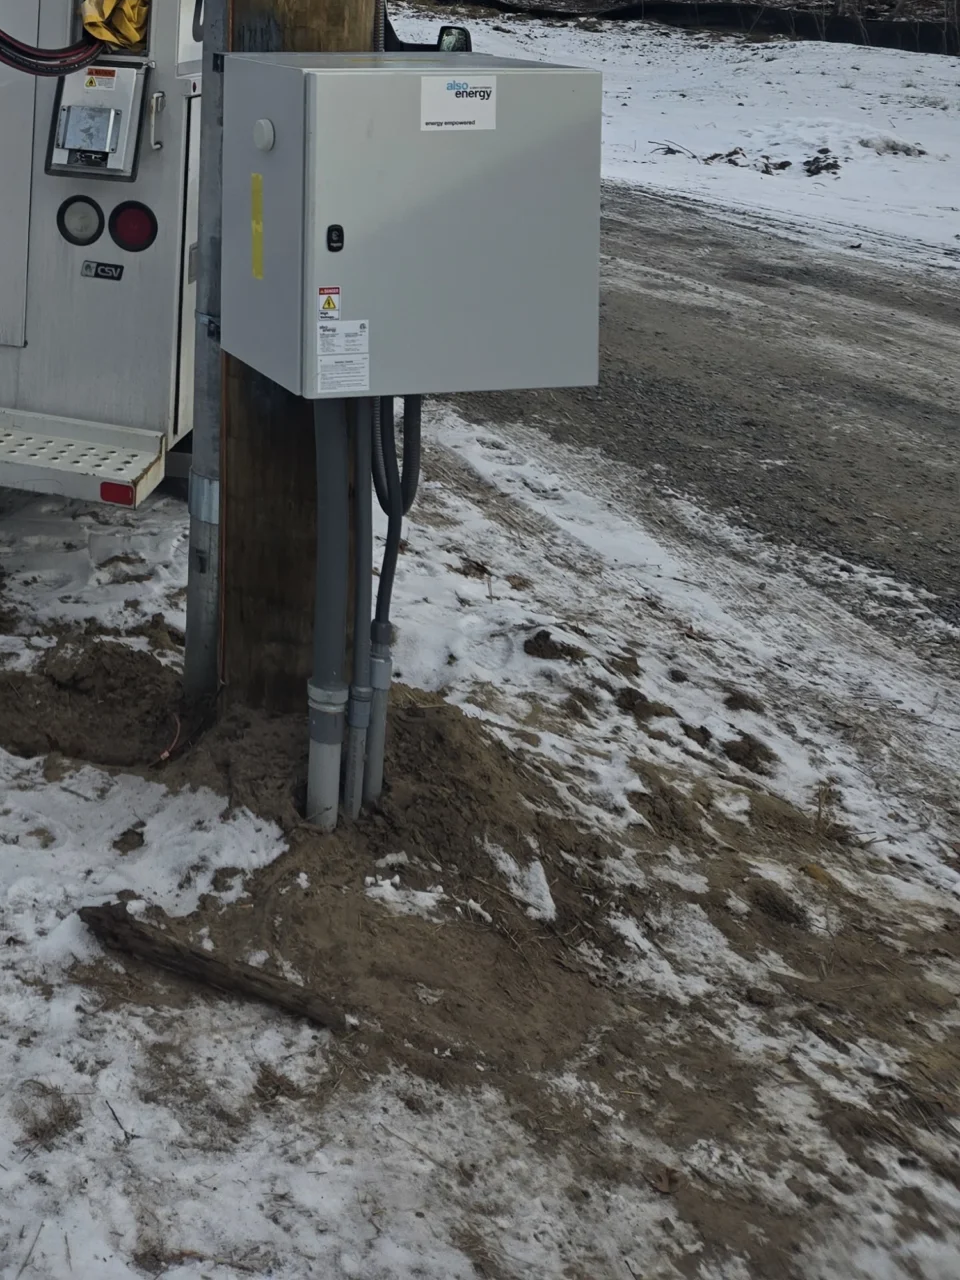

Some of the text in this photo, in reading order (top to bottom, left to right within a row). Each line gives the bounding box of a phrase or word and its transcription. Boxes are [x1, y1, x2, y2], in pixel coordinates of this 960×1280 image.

[446, 80, 469, 91] also
[455, 90, 492, 100] energy
[97, 265, 120, 278] CSV
